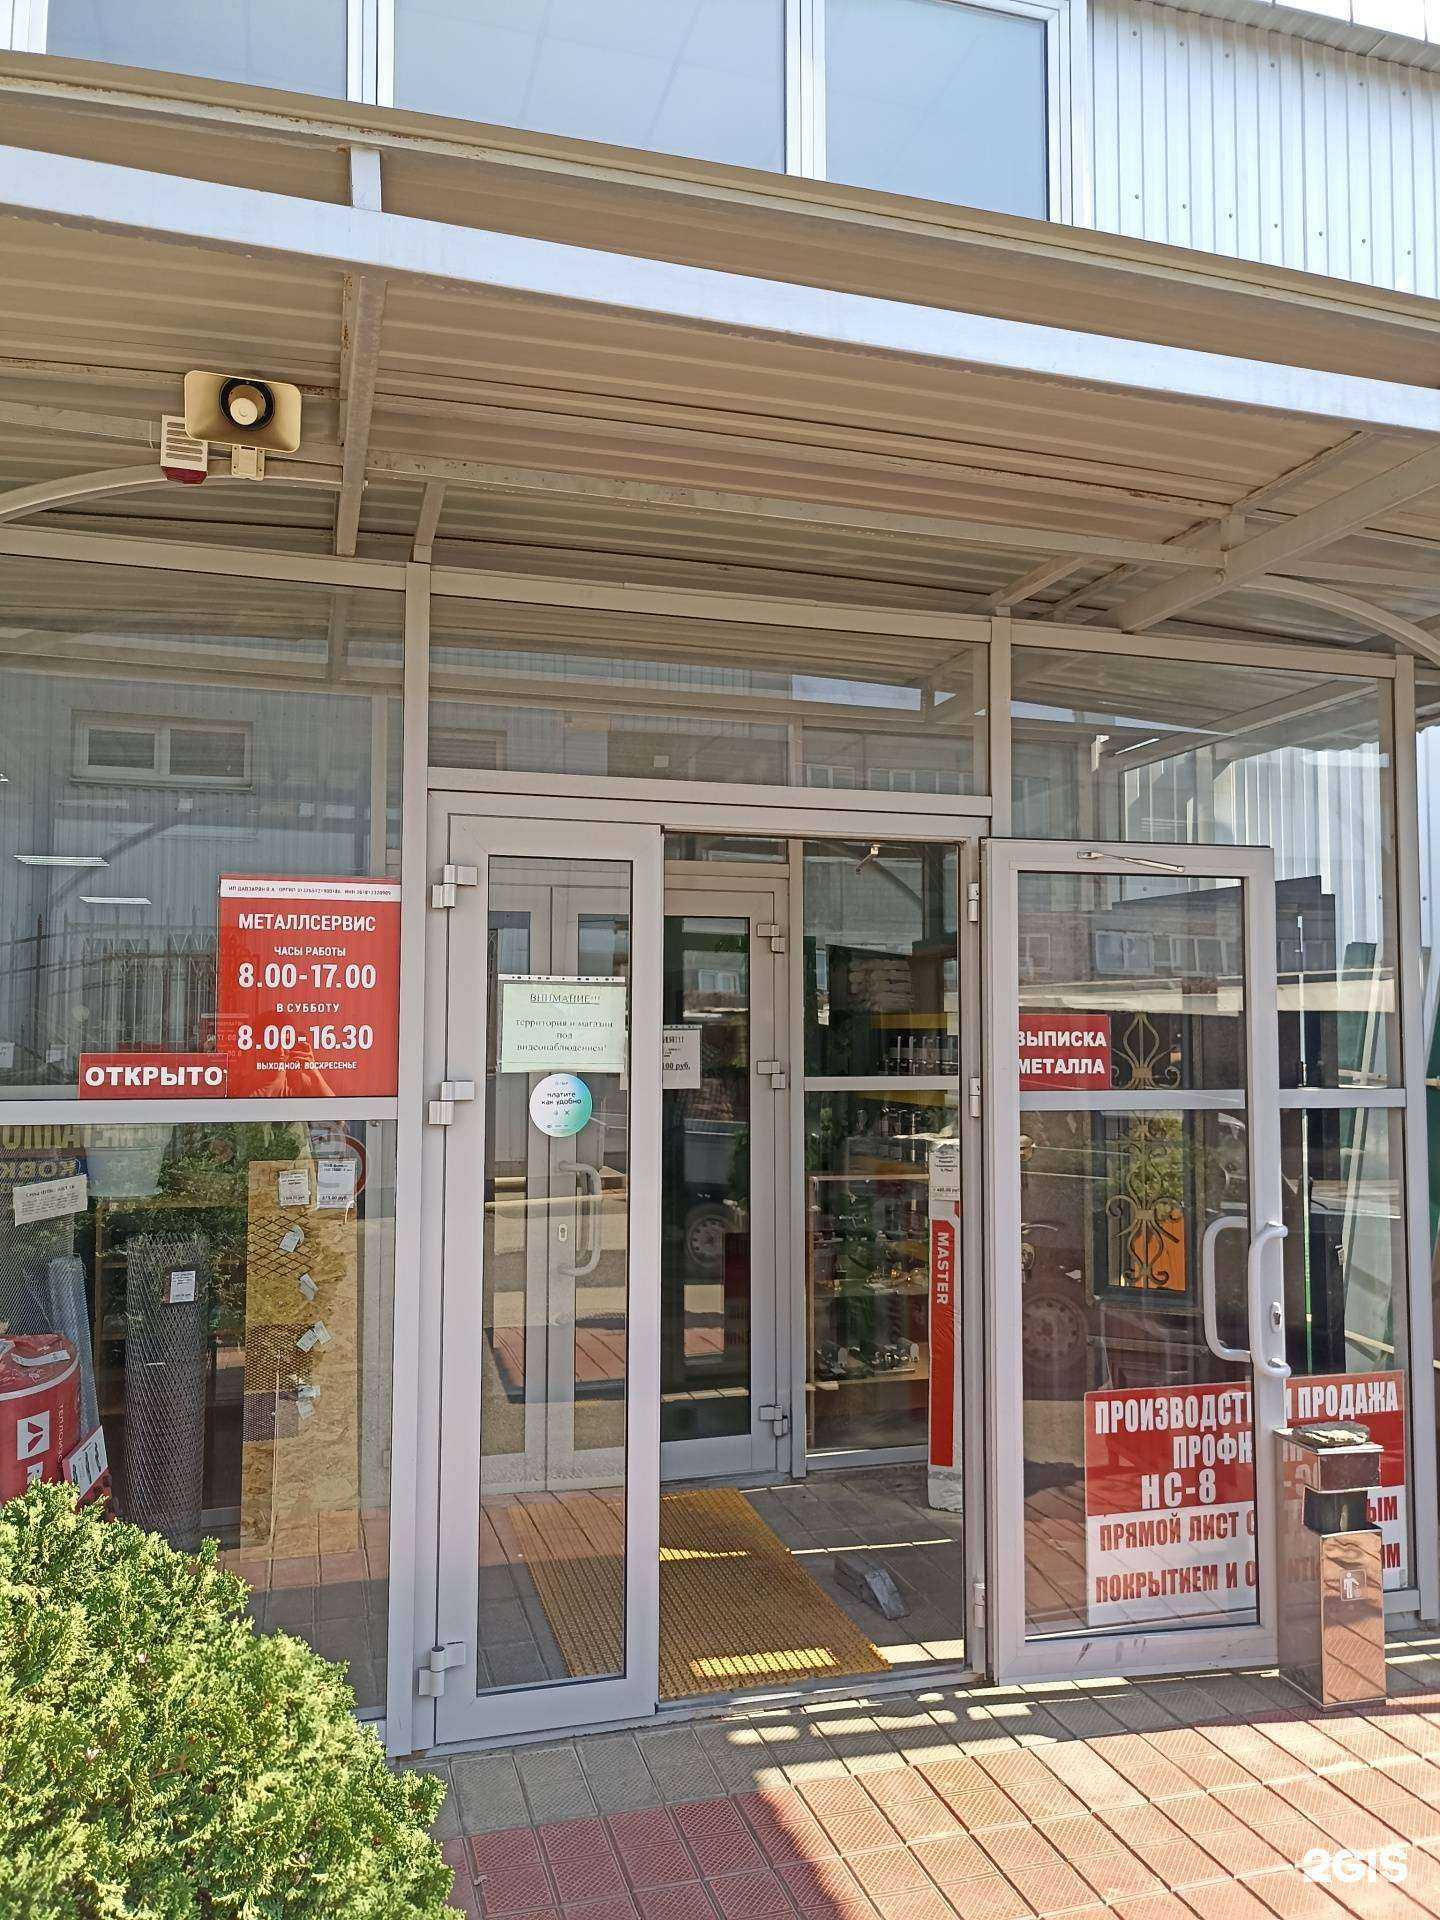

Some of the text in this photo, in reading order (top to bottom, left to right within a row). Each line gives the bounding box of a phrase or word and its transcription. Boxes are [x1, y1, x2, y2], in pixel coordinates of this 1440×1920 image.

[238, 913, 376, 932] МЕТАЛЛСЕРВИС
[274, 946, 346, 957] ЧАСЫ РАБОТЫ
[238, 962, 377, 989] 8.00-17.00
[276, 1003, 340, 1013] В СУББОТУ
[237, 1025, 374, 1050] 8.00-16.30
[1019, 1030, 1108, 1047] ВЫПИСКА
[85, 1066, 223, 1087] ОТКРЫТО
[256, 1060, 358, 1071] ВЫХОДНОЙ ВОСКРЕСЕНЬЕ
[1019, 1058, 1106, 1075] МЕТАЛЛА
[555, 1098, 582, 1106] удобно
[936, 1231, 950, 1305] MASTER
[1095, 1391, 1252, 1434] ПРОИЗВОДСТ
[1298, 1381, 1399, 1420] ПРОДАЖА
[1173, 1431, 1252, 1469] ПРОФН
[1141, 1468, 1217, 1509] НС-8
[1099, 1512, 1182, 1551] ПРЯМОЙ
[1188, 1512, 1238, 1542] ЛИСТ
[1095, 1564, 1218, 1603] ПОКРЫТИЕМ
[1226, 1563, 1237, 1589] И
